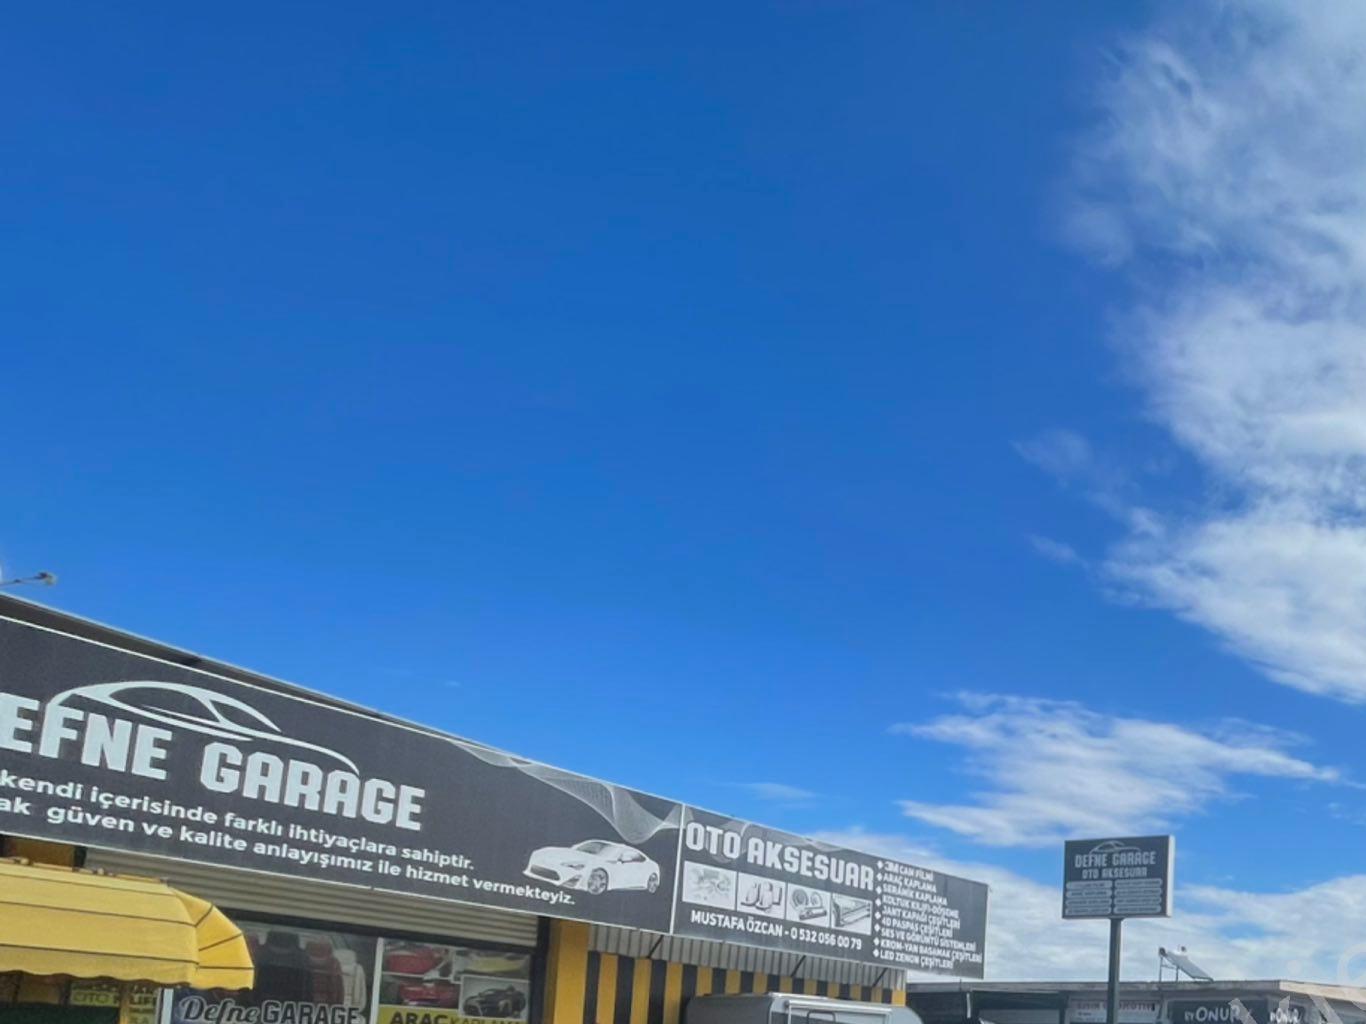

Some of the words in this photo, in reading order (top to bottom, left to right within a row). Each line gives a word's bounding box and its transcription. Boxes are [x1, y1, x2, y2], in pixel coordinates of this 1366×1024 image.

[200, 741, 426, 831] GARAGE
[0, 769, 83, 800] kendi
[90, 786, 218, 825] içerisinde
[224, 811, 282, 836] farklı
[288, 823, 397, 857] ihtiyaçlara
[401, 847, 475, 870] sahiptir.
[46, 804, 135, 833] güven
[141, 822, 173, 839] ve
[179, 825, 247, 851] kalite
[253, 843, 373, 871] anlayışımız
[378, 858, 402, 876] ile
[405, 864, 470, 887] hizmet
[472, 878, 576, 905] vermekteyiz.
[685, 822, 741, 860] OTO
[747, 838, 874, 891] AKSESUAR
[1075, 853, 1108, 868] DEFNE
[1112, 851, 1157, 866] GARAGE
[1082, 869, 1099, 879] OTO
[691, 910, 745, 932] MUSTAFA
[746, 915, 783, 937] ÖZCAN
[790, 927, 798, 940] 0
[799, 928, 817, 943] 532
[818, 932, 836, 946] 056
[837, 935, 850, 948] 00
[850, 937, 863, 950] 79
[1195, 1005, 1241, 1024] ONUR
